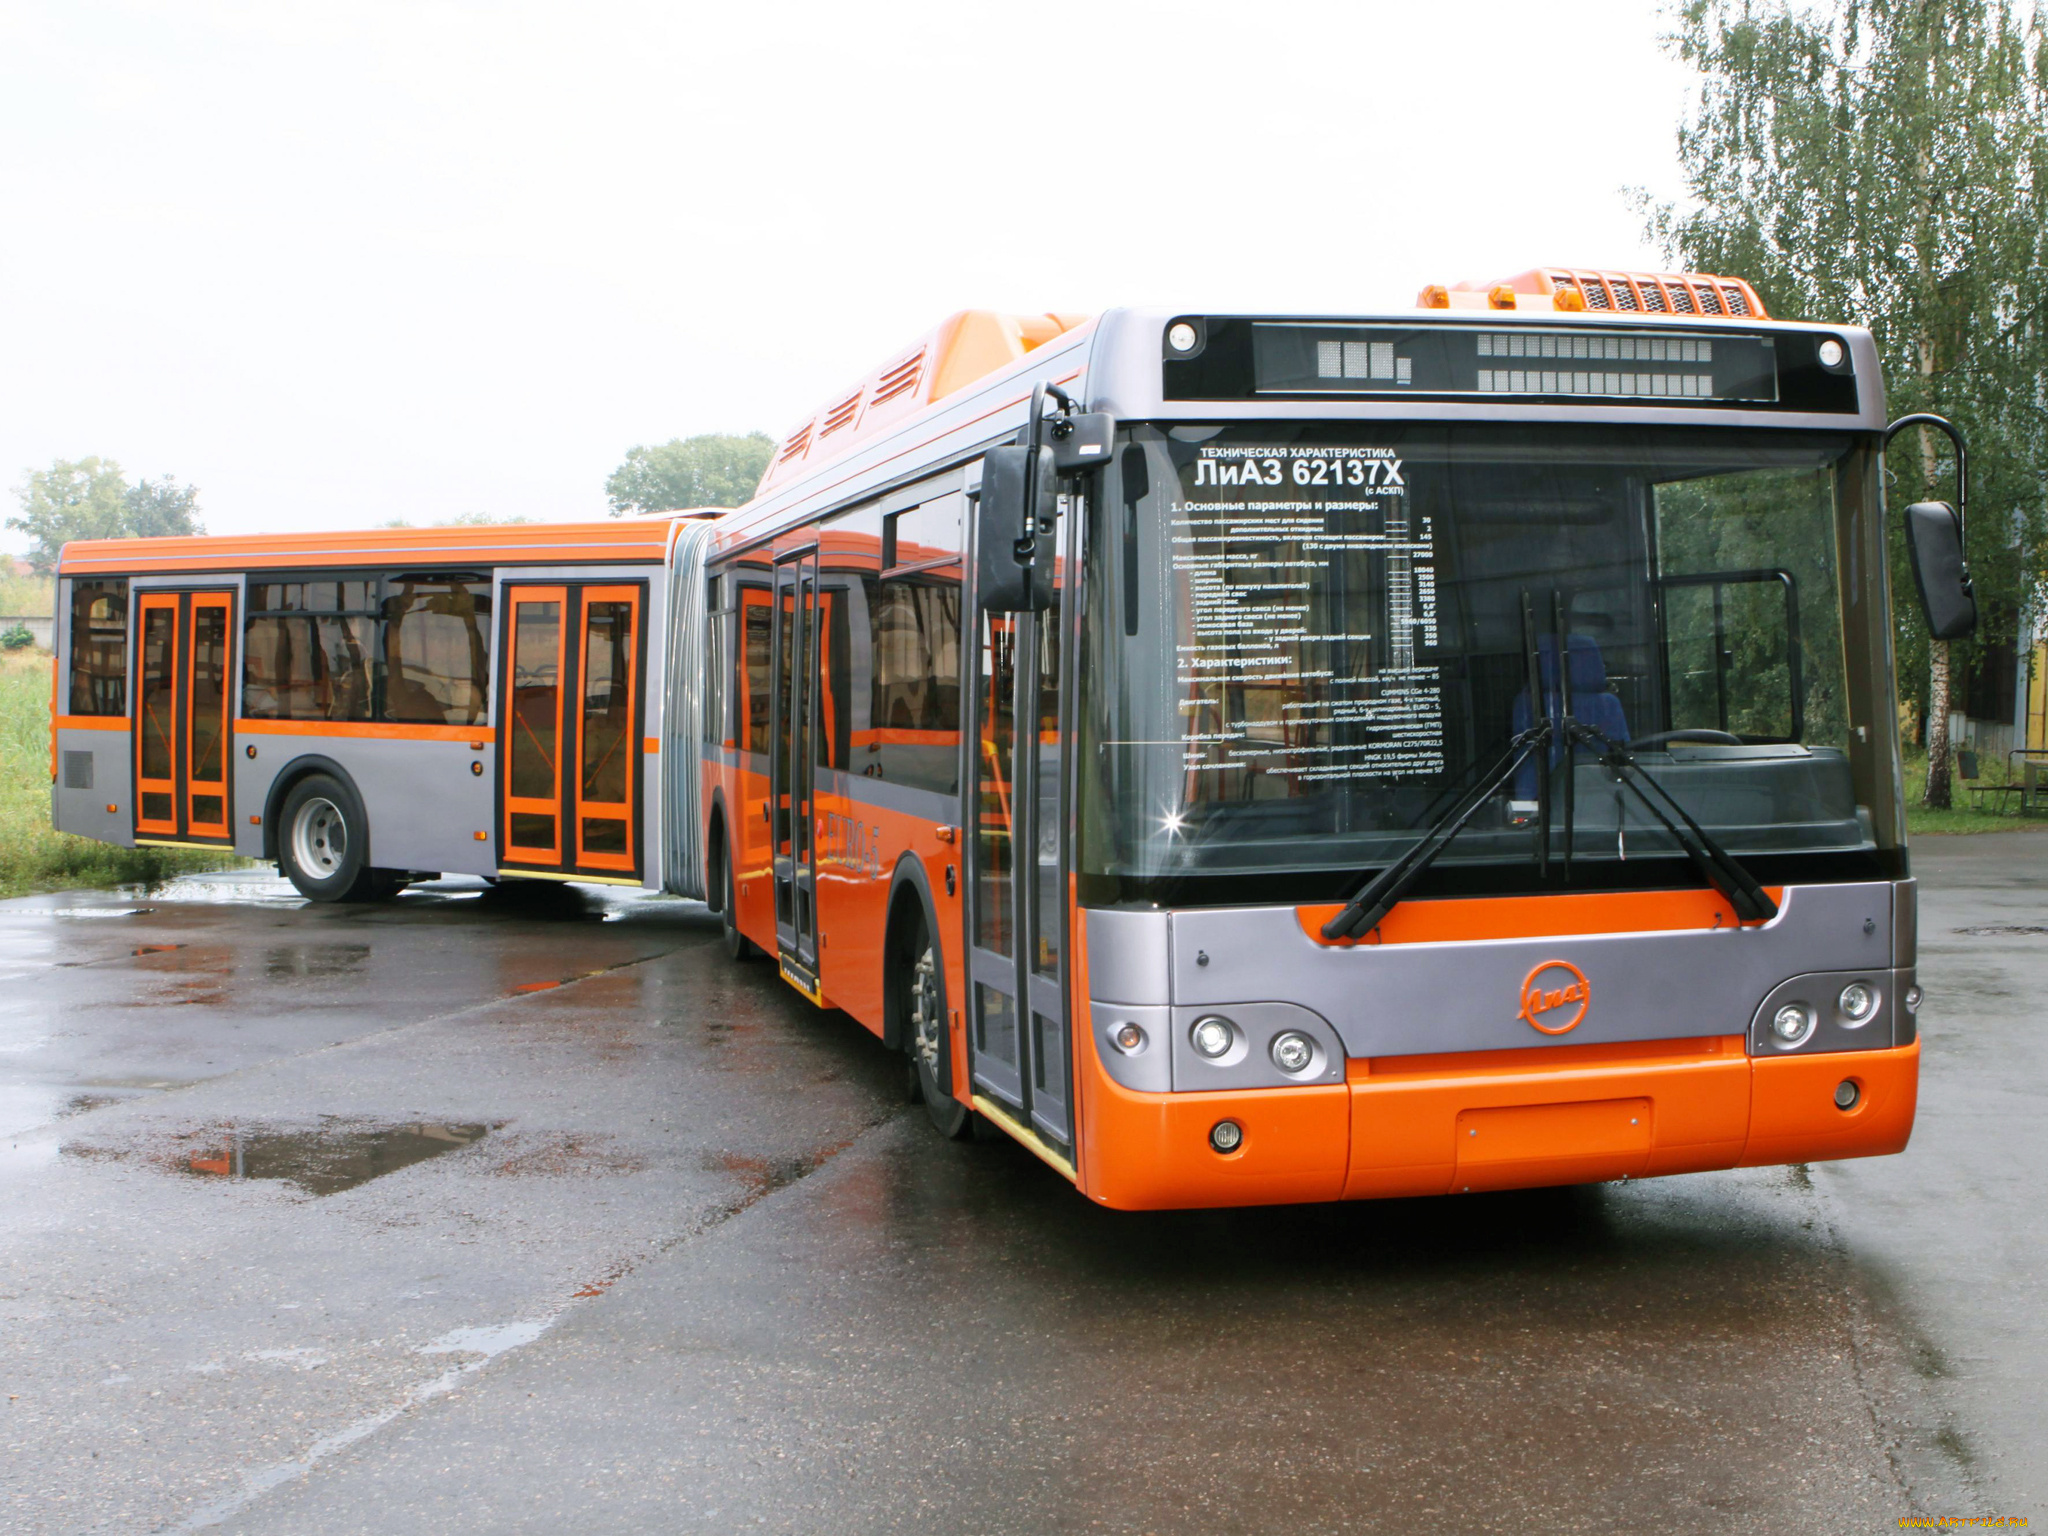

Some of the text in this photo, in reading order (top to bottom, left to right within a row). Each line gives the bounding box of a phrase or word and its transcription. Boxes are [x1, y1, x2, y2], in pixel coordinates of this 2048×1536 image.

[1200, 448, 1395, 458] ТЕХНИЧЕСКАЯ ХАРАКТЕРИСТИКА
[1194, 459, 1283, 486] ЛиАЗ
[1365, 486, 1404, 496] (с АСКП)
[1171, 502, 1378, 512] 1. Основные параметры и размеры:
[1285, 560, 1317, 568] автобуса,
[1285, 604, 1310, 612] менее)
[1277, 612, 1301, 620] менее)
[1322, 633, 1346, 641] задней
[1177, 656, 1292, 669] 2. Характеристики:
[1181, 733, 1211, 741] Коробка
[1213, 732, 1245, 740] передач:
[828, 812, 879, 880] EURO-5
